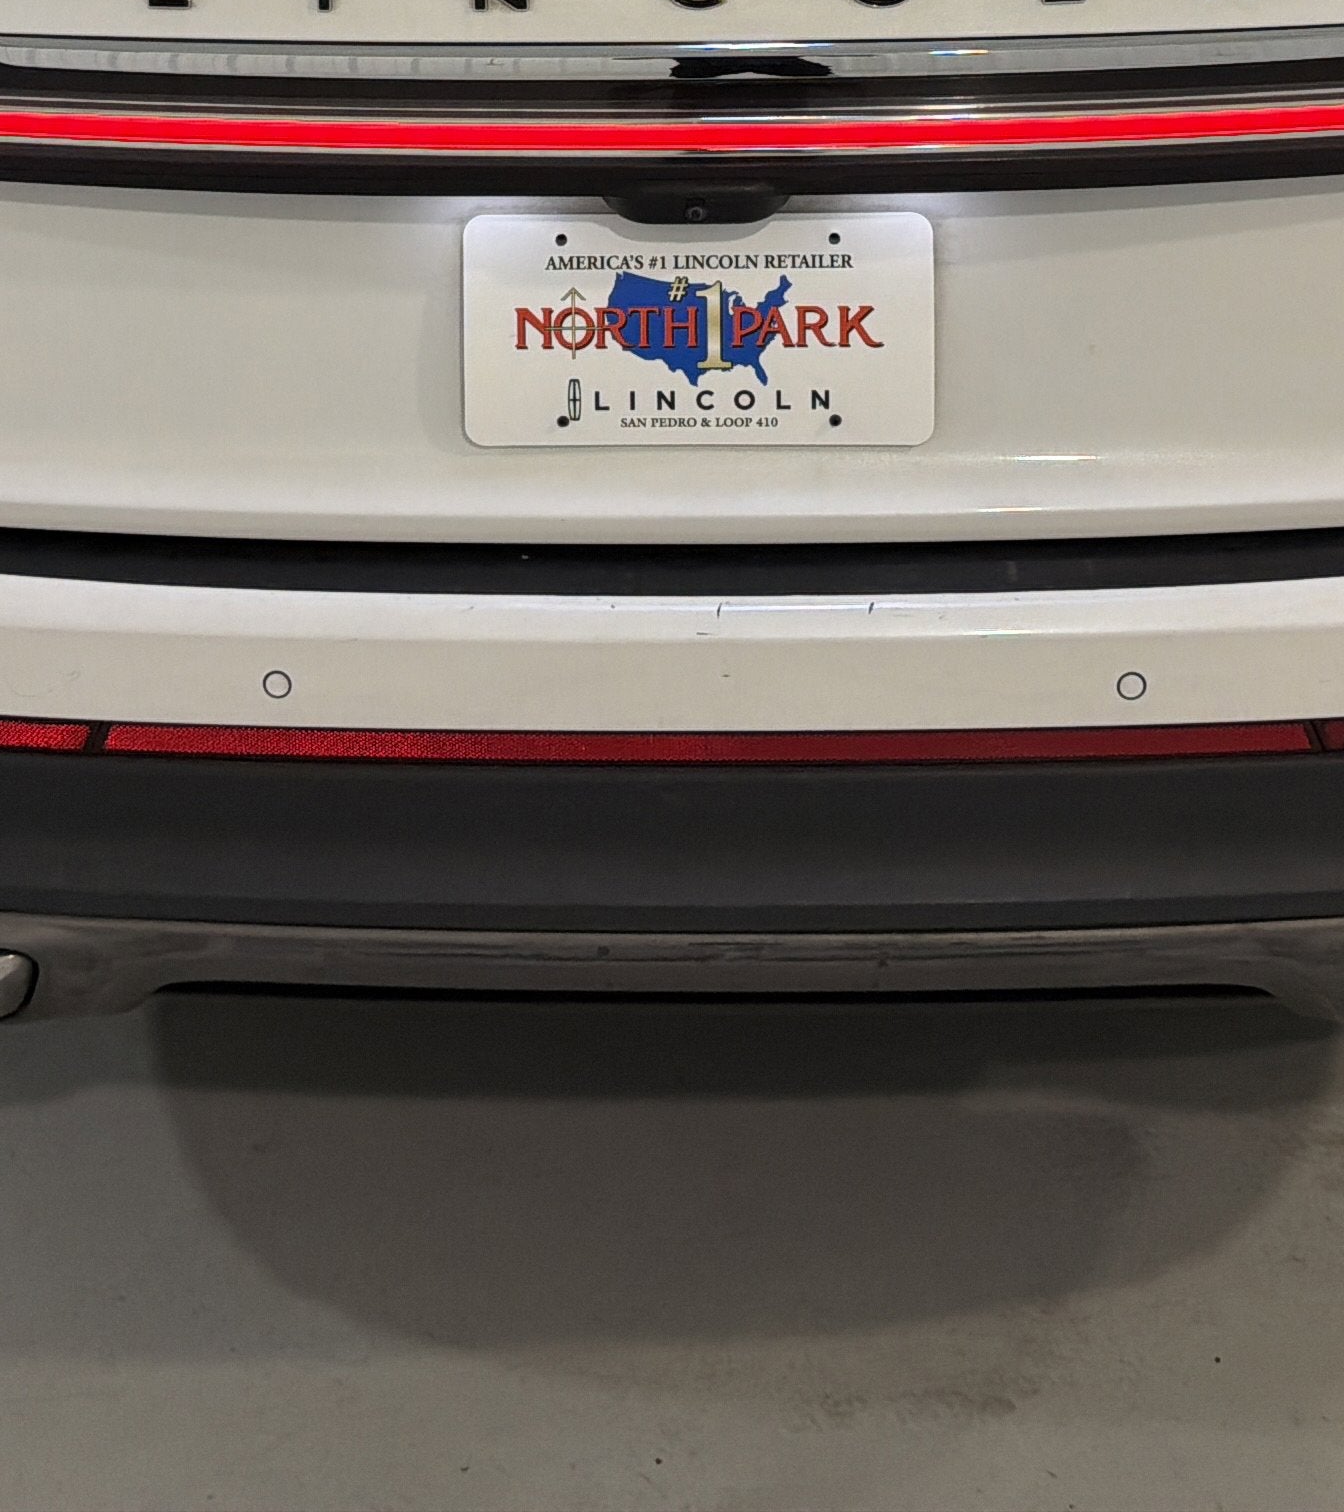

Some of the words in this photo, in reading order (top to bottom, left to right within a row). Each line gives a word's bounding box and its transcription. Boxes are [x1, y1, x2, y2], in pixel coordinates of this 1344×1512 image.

[545, 254, 644, 271] AMERICA'S
[649, 254, 667, 270] #1
[673, 254, 758, 270] LINCOLN
[764, 253, 854, 269] RETAILER
[514, 305, 698, 350] NORTH
[730, 305, 885, 348] PARK
[594, 389, 831, 411] LINCOLN
[620, 417, 647, 428] SAN
[651, 417, 697, 428] PEDRO
[701, 417, 712, 428] &
[715, 417, 752, 428] LOOP
[756, 416, 778, 428] 410
